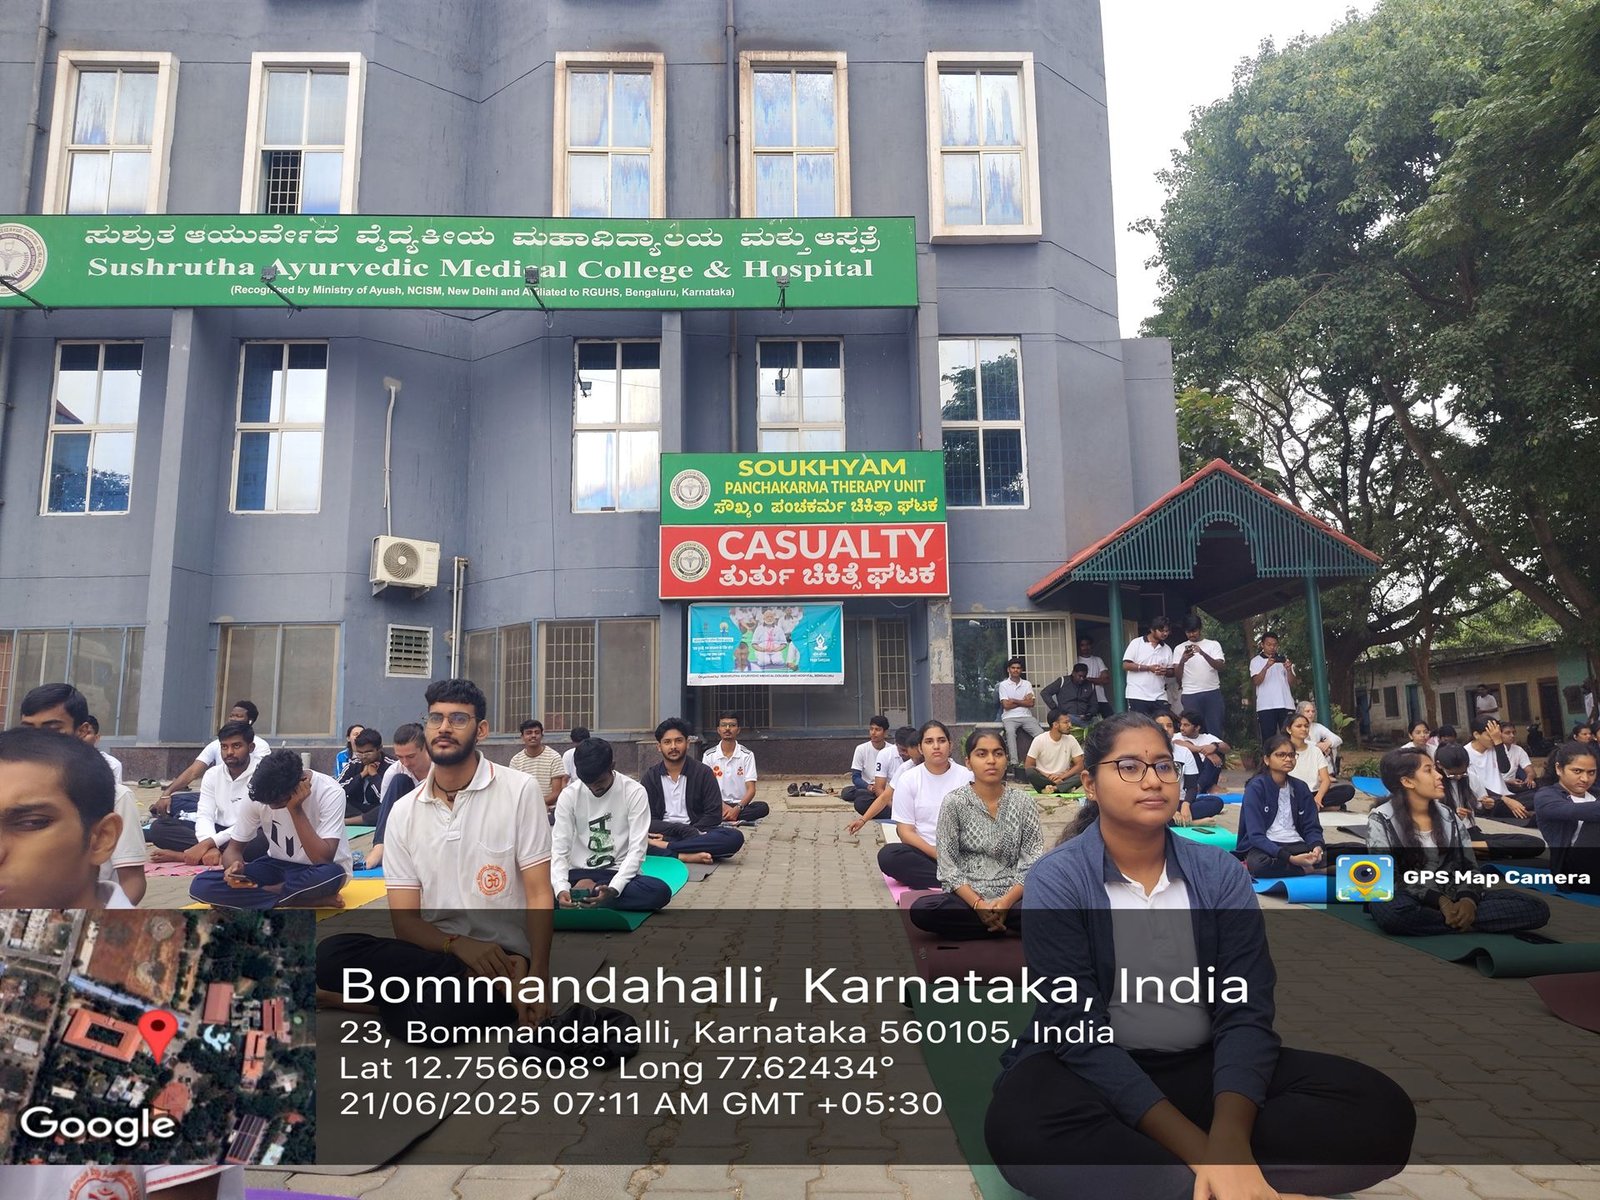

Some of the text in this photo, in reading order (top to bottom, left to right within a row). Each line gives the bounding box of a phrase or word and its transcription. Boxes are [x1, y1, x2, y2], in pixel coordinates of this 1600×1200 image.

[84, 224, 881, 256] ಸುಶ್ರುತ ಆಯುರ್ವೇದ ವೈದ್ಯಕೀಯ ಮಹಾವಿದ್ಯಾಲಯ ಮತ್ತು ಆಸ್ಪತ್ರೆ
[88, 258, 255, 277] Sushrutha
[270, 258, 429, 280] Ayurvedic
[578, 260, 694, 283] College
[703, 260, 732, 279] &
[743, 259, 873, 283] Hospital
[297, 285, 310, 297] by
[313, 285, 354, 297] Ministry
[356, 285, 368, 295] of
[369, 286, 405, 297] Ayush,
[407, 286, 445, 297] NCISM,
[447, 287, 470, 296] New
[472, 287, 498, 296] Delhi
[500, 287, 520, 296] and
[569, 288, 580, 297] to
[582, 287, 623, 298] RGUHS,
[625, 288, 679, 299] Bengaluru,
[681, 287, 735, 298] Karnataka)
[738, 458, 906, 477] SOUKHYAM
[725, 479, 926, 495] PANCHAKARMA THERAPY UNIT
[897, 497, 938, 515] ಘಟಕ
[717, 528, 935, 561] CASUALTY
[719, 561, 937, 590] ತುರ್ತು ಚಿಕಿತ್ಸೆ ಘಟಕ
[876, 762, 882, 772] 3
